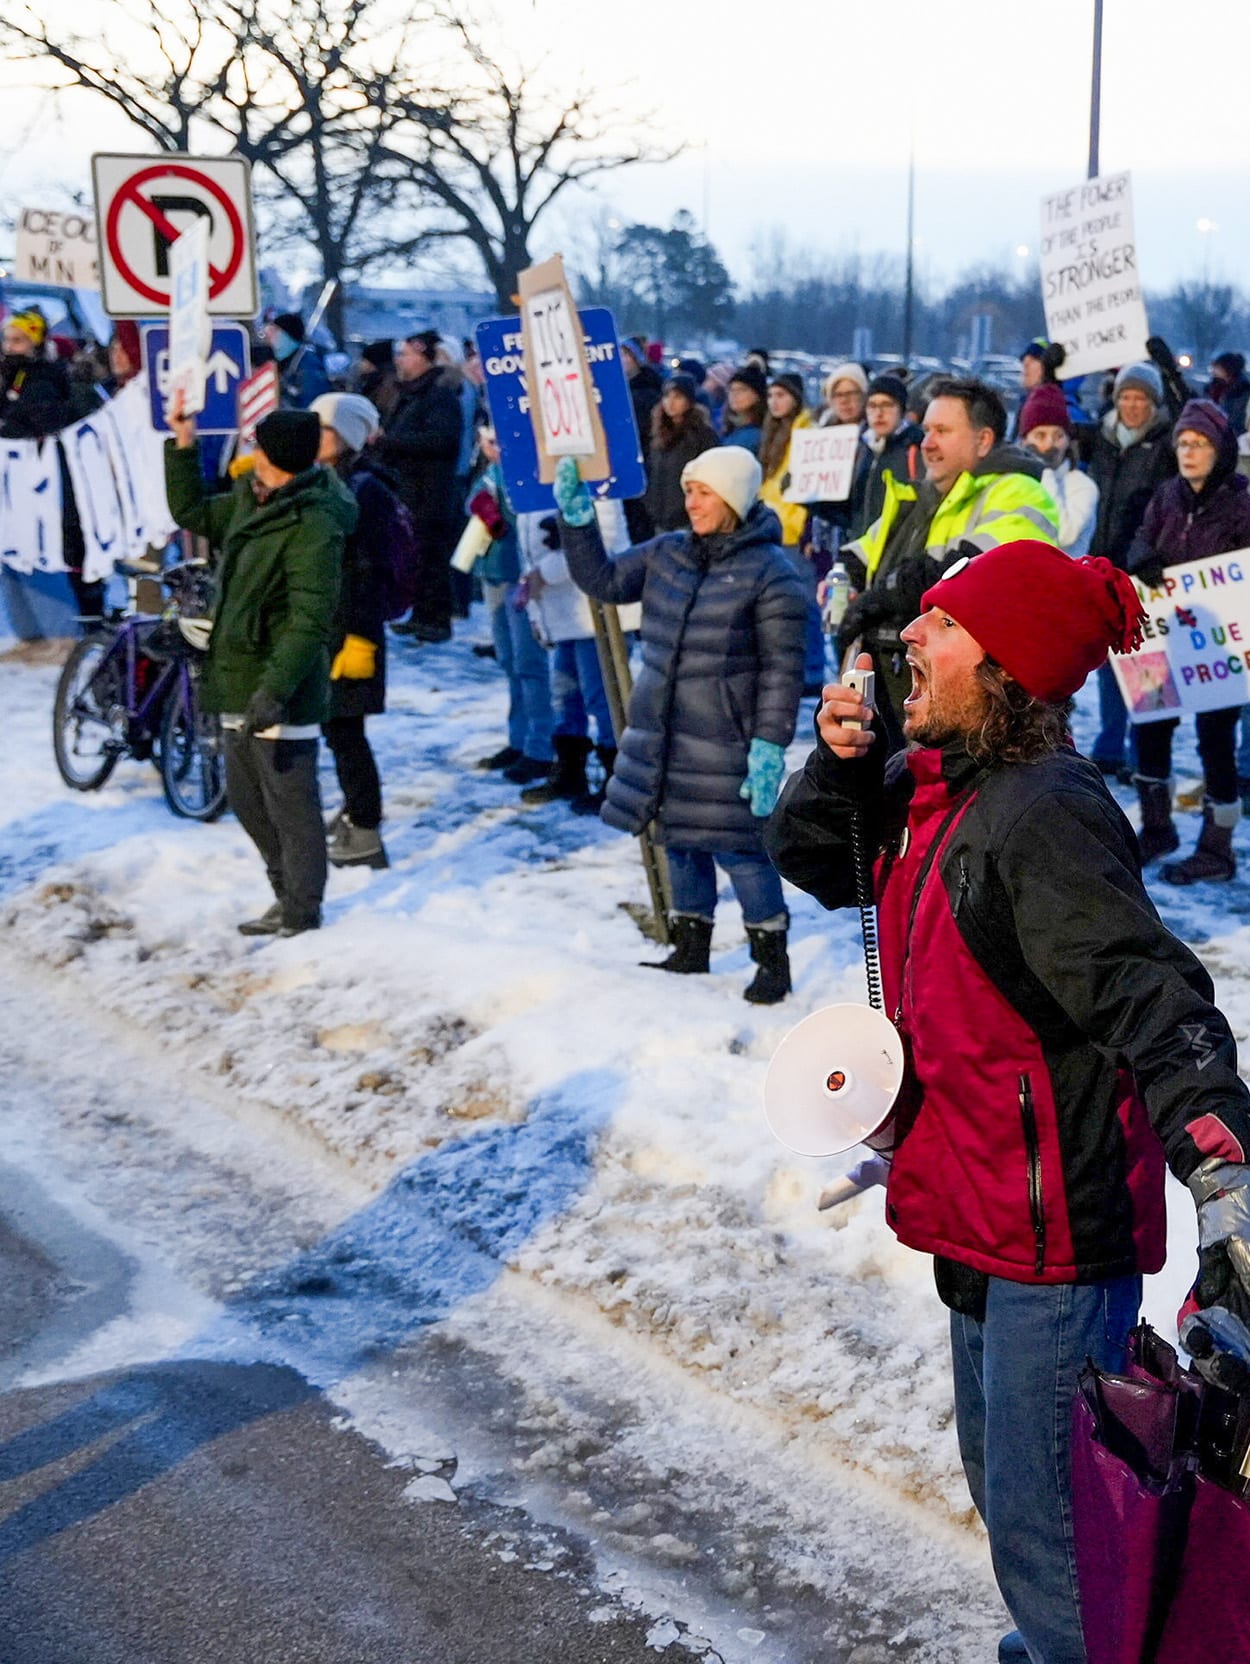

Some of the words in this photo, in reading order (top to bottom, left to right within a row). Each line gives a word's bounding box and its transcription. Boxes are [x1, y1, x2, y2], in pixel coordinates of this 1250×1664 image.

[1045, 189, 1075, 222] THE
[1081, 177, 1128, 211] POWER
[23, 211, 61, 234] ICE
[62, 214, 99, 243] OU
[1075, 238, 1097, 261] IS
[30, 256, 74, 282] MN
[1046, 244, 1136, 299] STRONGER
[543, 373, 582, 437] OUT
[1190, 623, 1243, 650] DUE
